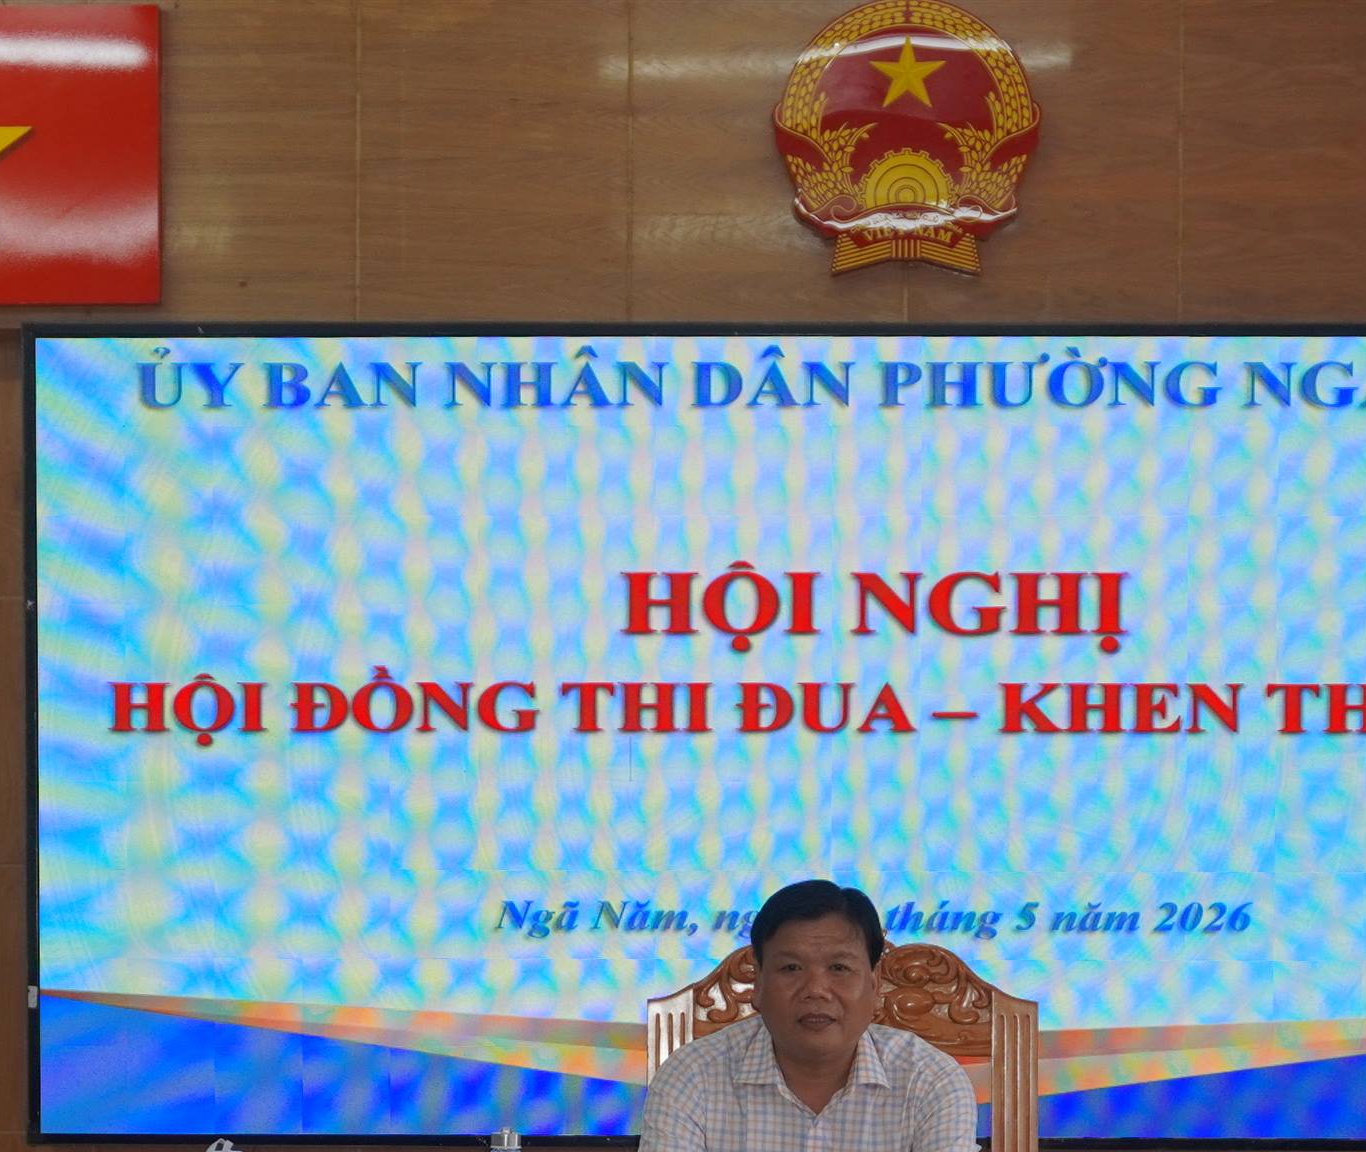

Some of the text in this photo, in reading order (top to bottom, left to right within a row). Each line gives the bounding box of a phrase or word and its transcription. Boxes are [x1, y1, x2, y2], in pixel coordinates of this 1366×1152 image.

[137, 346, 245, 409] ỦY
[262, 361, 423, 408] BAN
[444, 345, 671, 409] NHÂN
[691, 345, 856, 409] DÂN
[878, 346, 1224, 409] PHƯỜNG
[623, 560, 1125, 655] HỘI NGHỊ
[108, 672, 268, 747] HỘI
[289, 664, 541, 734] ĐỒNG
[561, 681, 715, 734] THI
[736, 681, 917, 734] ĐUA
[998, 682, 1244, 734] KHEN
[494, 900, 579, 938] Ngã
[589, 900, 699, 936] Năm,
[885, 900, 1002, 940] tháng
[1015, 901, 1040, 932] 5
[1051, 901, 1141, 933] năm
[1153, 901, 1254, 933] 2026
